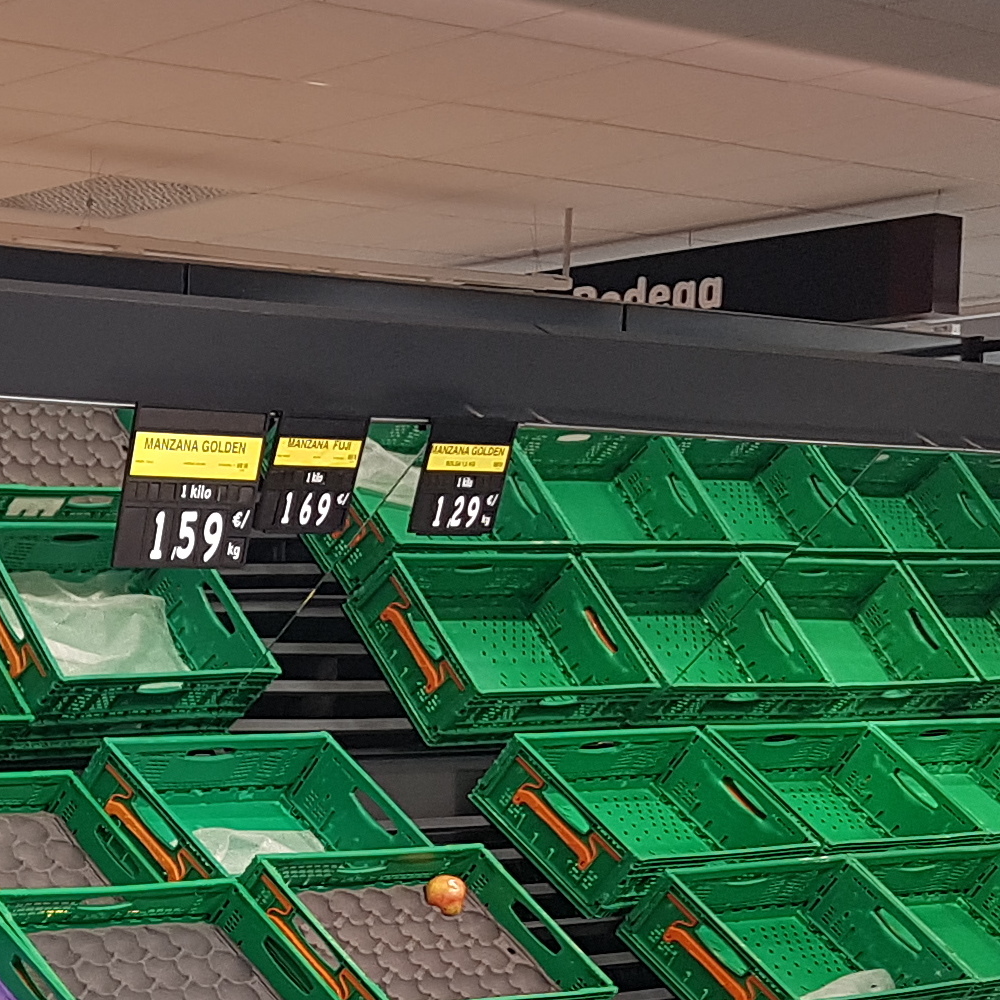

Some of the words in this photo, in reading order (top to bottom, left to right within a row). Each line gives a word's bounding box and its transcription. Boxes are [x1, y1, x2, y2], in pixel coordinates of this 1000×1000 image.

[144, 437, 198, 452] MANZANA
[202, 440, 247, 454] GOLDEN
[287, 438, 329, 450] MANZANA
[332, 440, 352, 451] FUJI
[432, 445, 470, 455] MANZANA
[471, 446, 505, 456] GOLDEN
[180, 484, 187, 498] 1
[190, 484, 212, 500] kilo
[226, 541, 241, 560] kg
